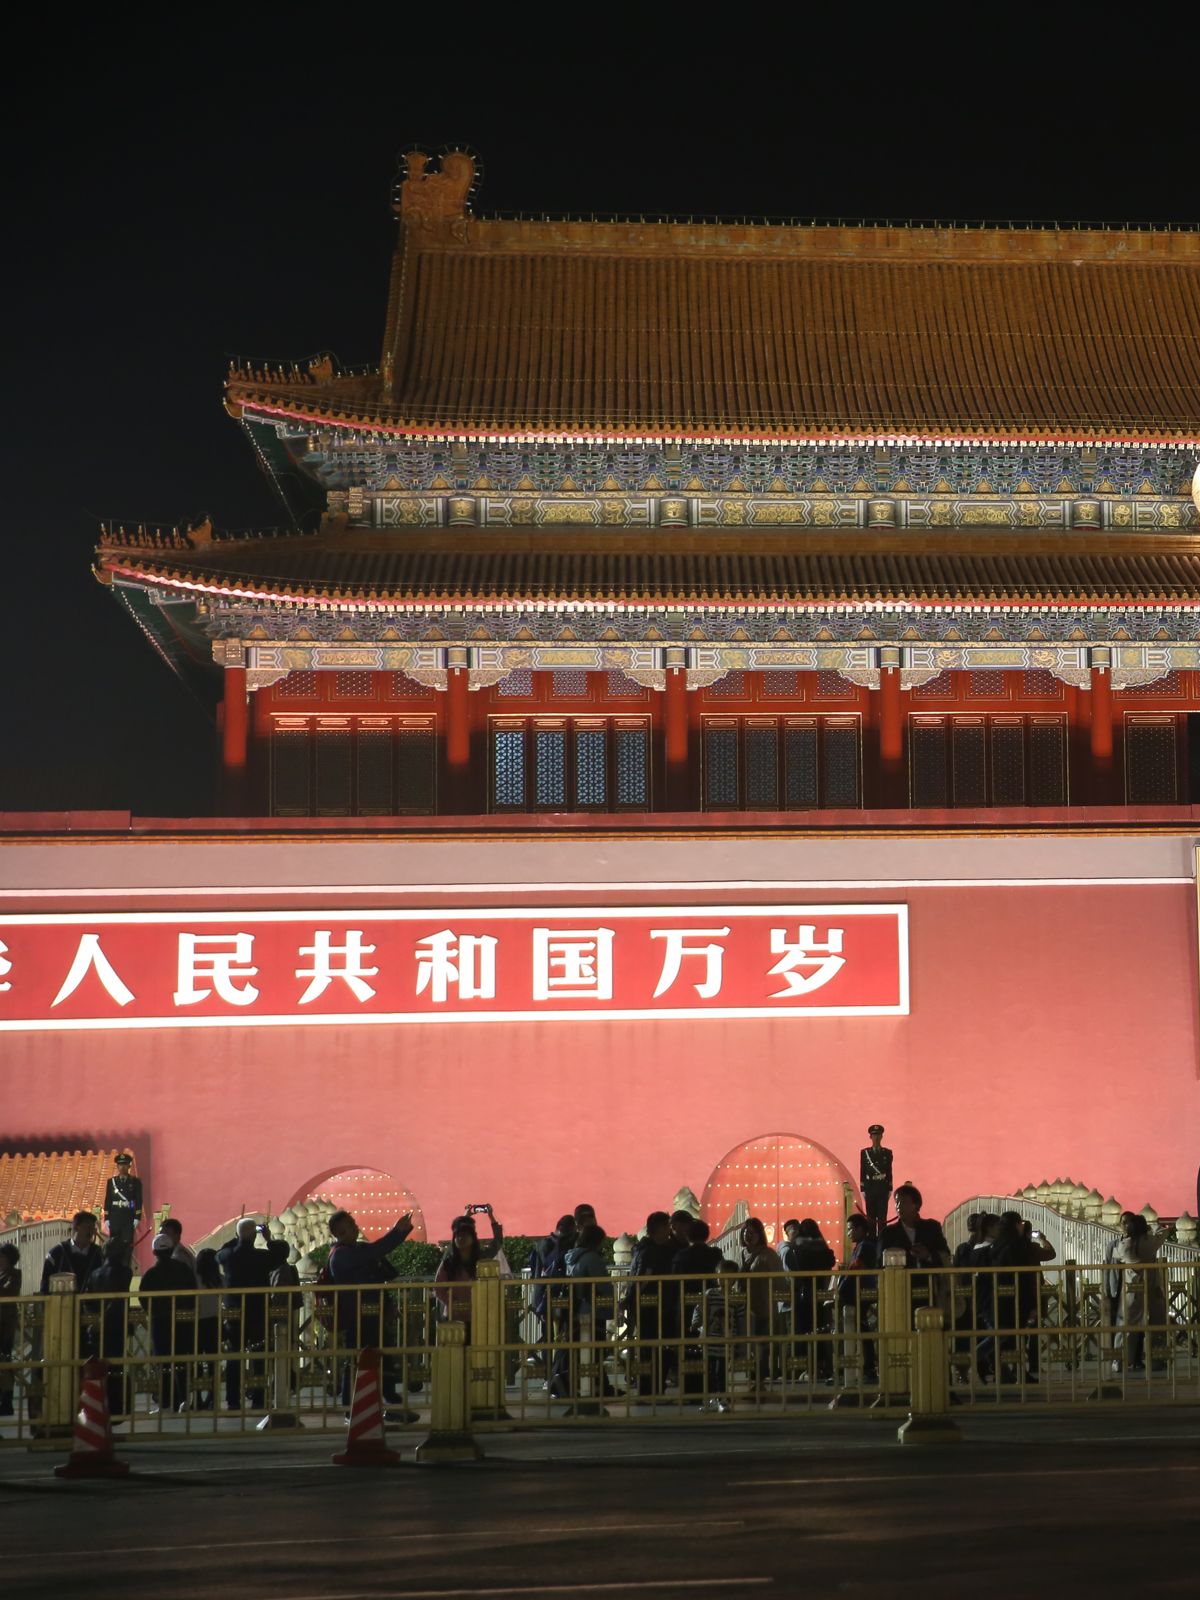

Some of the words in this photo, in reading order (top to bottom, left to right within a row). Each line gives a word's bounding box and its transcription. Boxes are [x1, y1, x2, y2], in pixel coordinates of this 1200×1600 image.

[0, 925, 847, 1008] 人民共和国万岁
